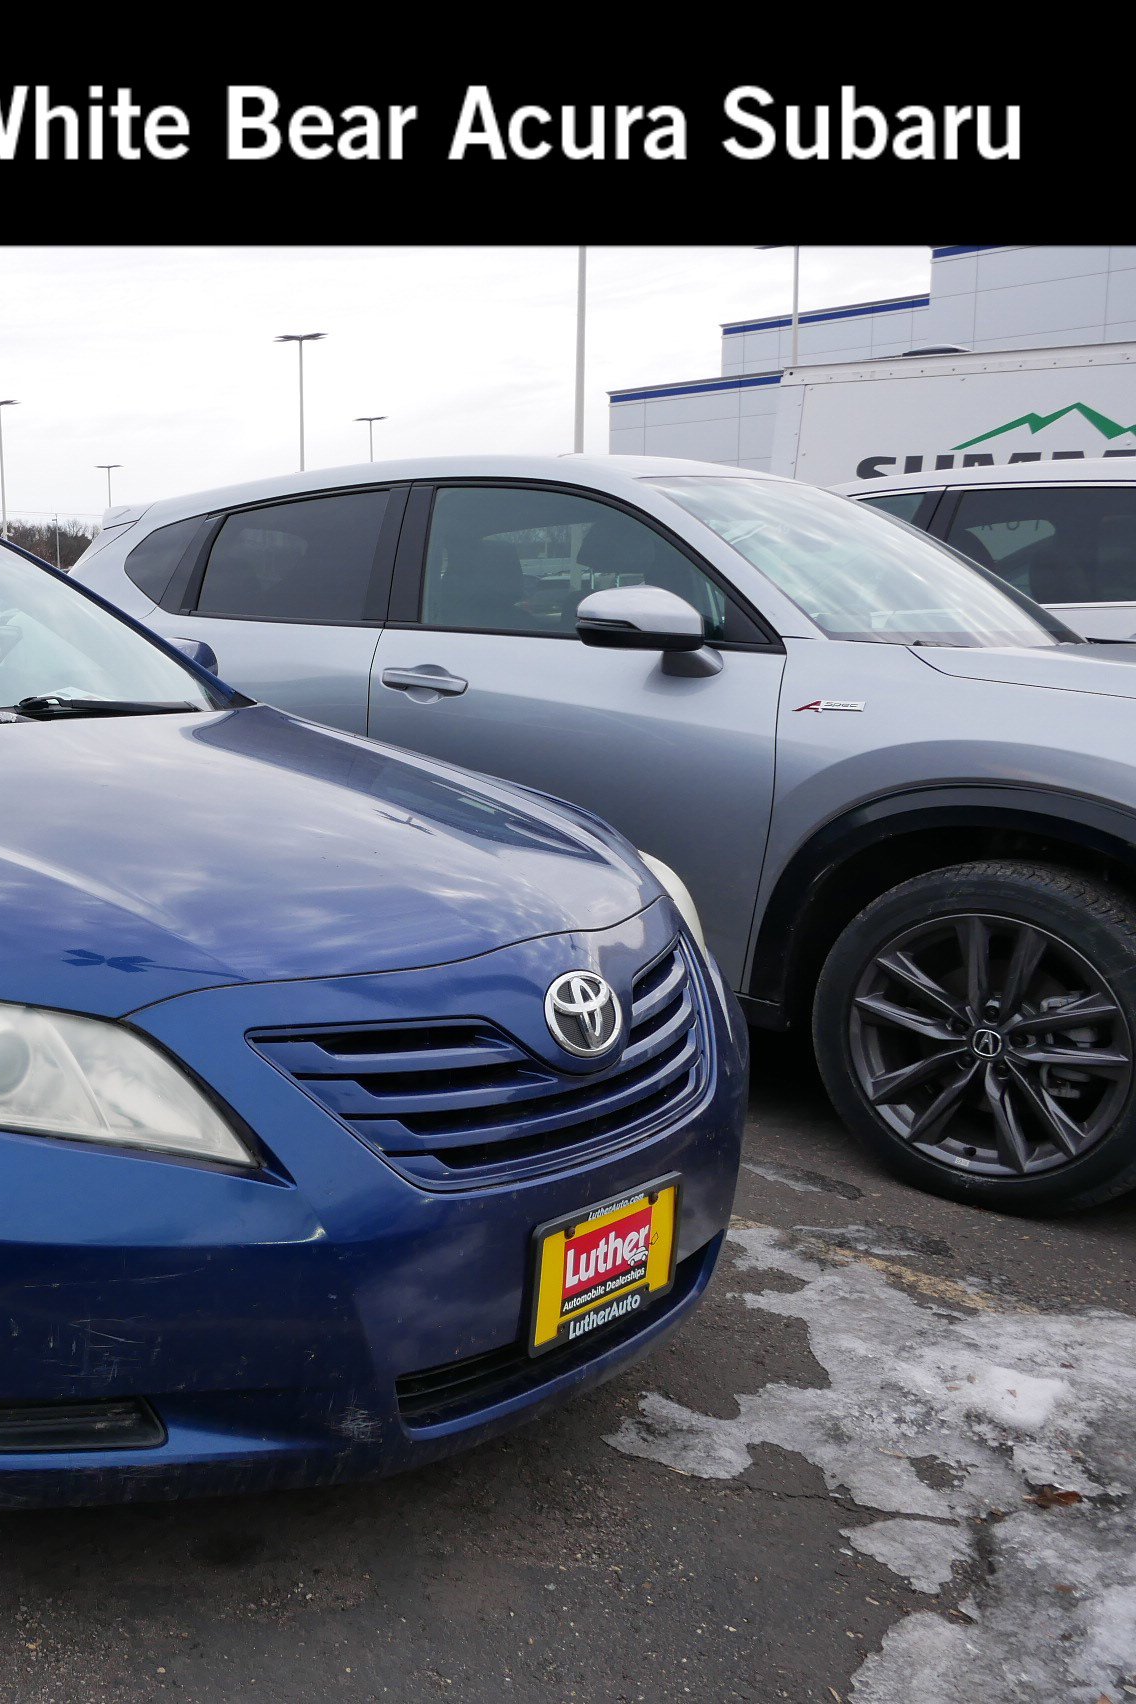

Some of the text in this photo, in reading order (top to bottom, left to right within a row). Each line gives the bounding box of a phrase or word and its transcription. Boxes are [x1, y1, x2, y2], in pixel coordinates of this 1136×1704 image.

[587, 1192, 645, 1221] LutherAuto.com
[565, 1224, 650, 1288] Luther
[562, 1267, 645, 1312] Automobile Dealerships
[568, 1294, 641, 1340] LutherAuto
